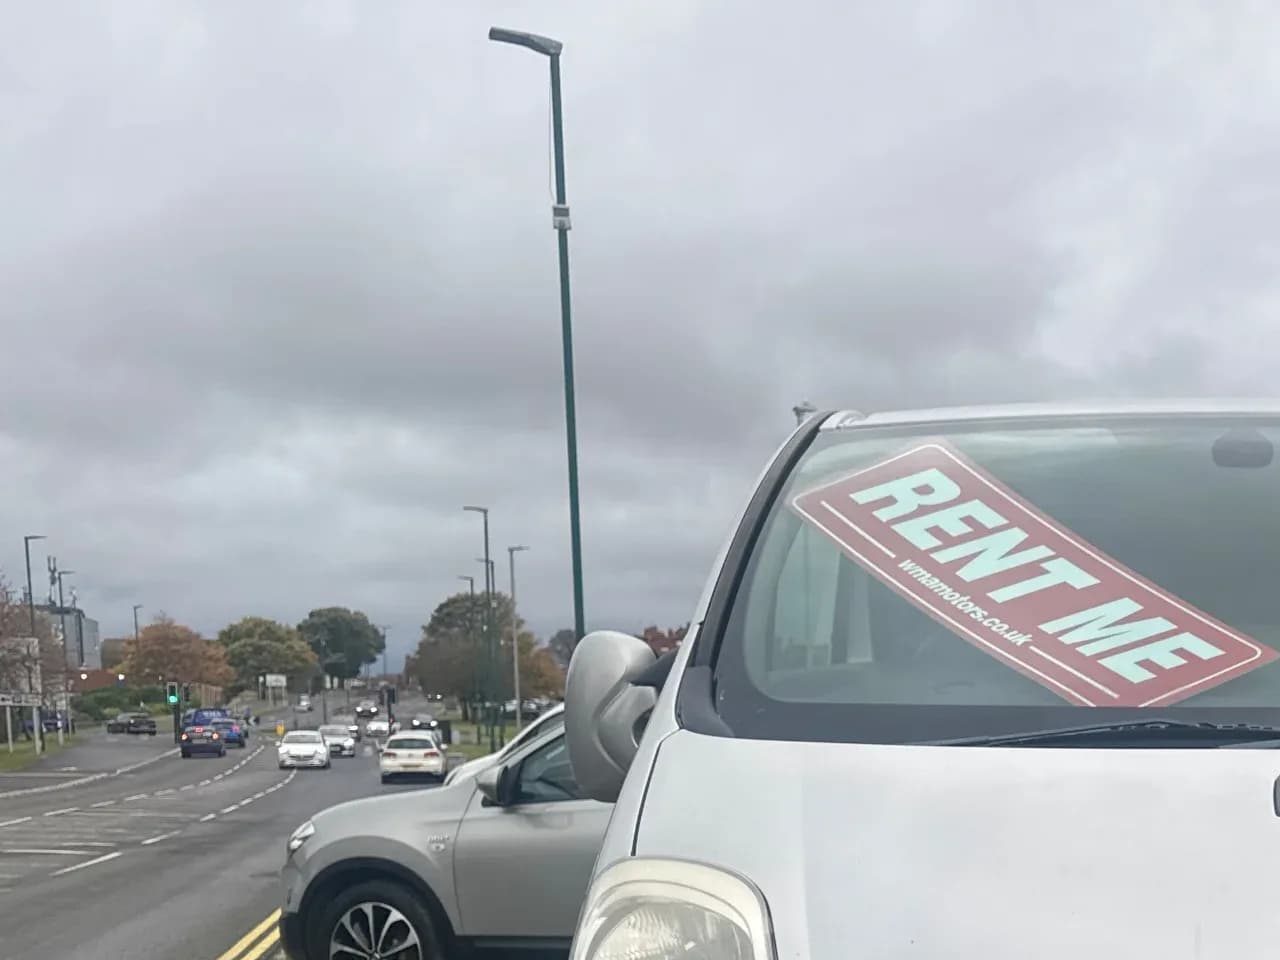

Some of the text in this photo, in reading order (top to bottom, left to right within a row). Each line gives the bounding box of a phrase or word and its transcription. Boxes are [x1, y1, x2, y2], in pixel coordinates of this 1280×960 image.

[849, 468, 1226, 683] RENT ME
[898, 558, 1033, 648] wmamotors.co.uk
